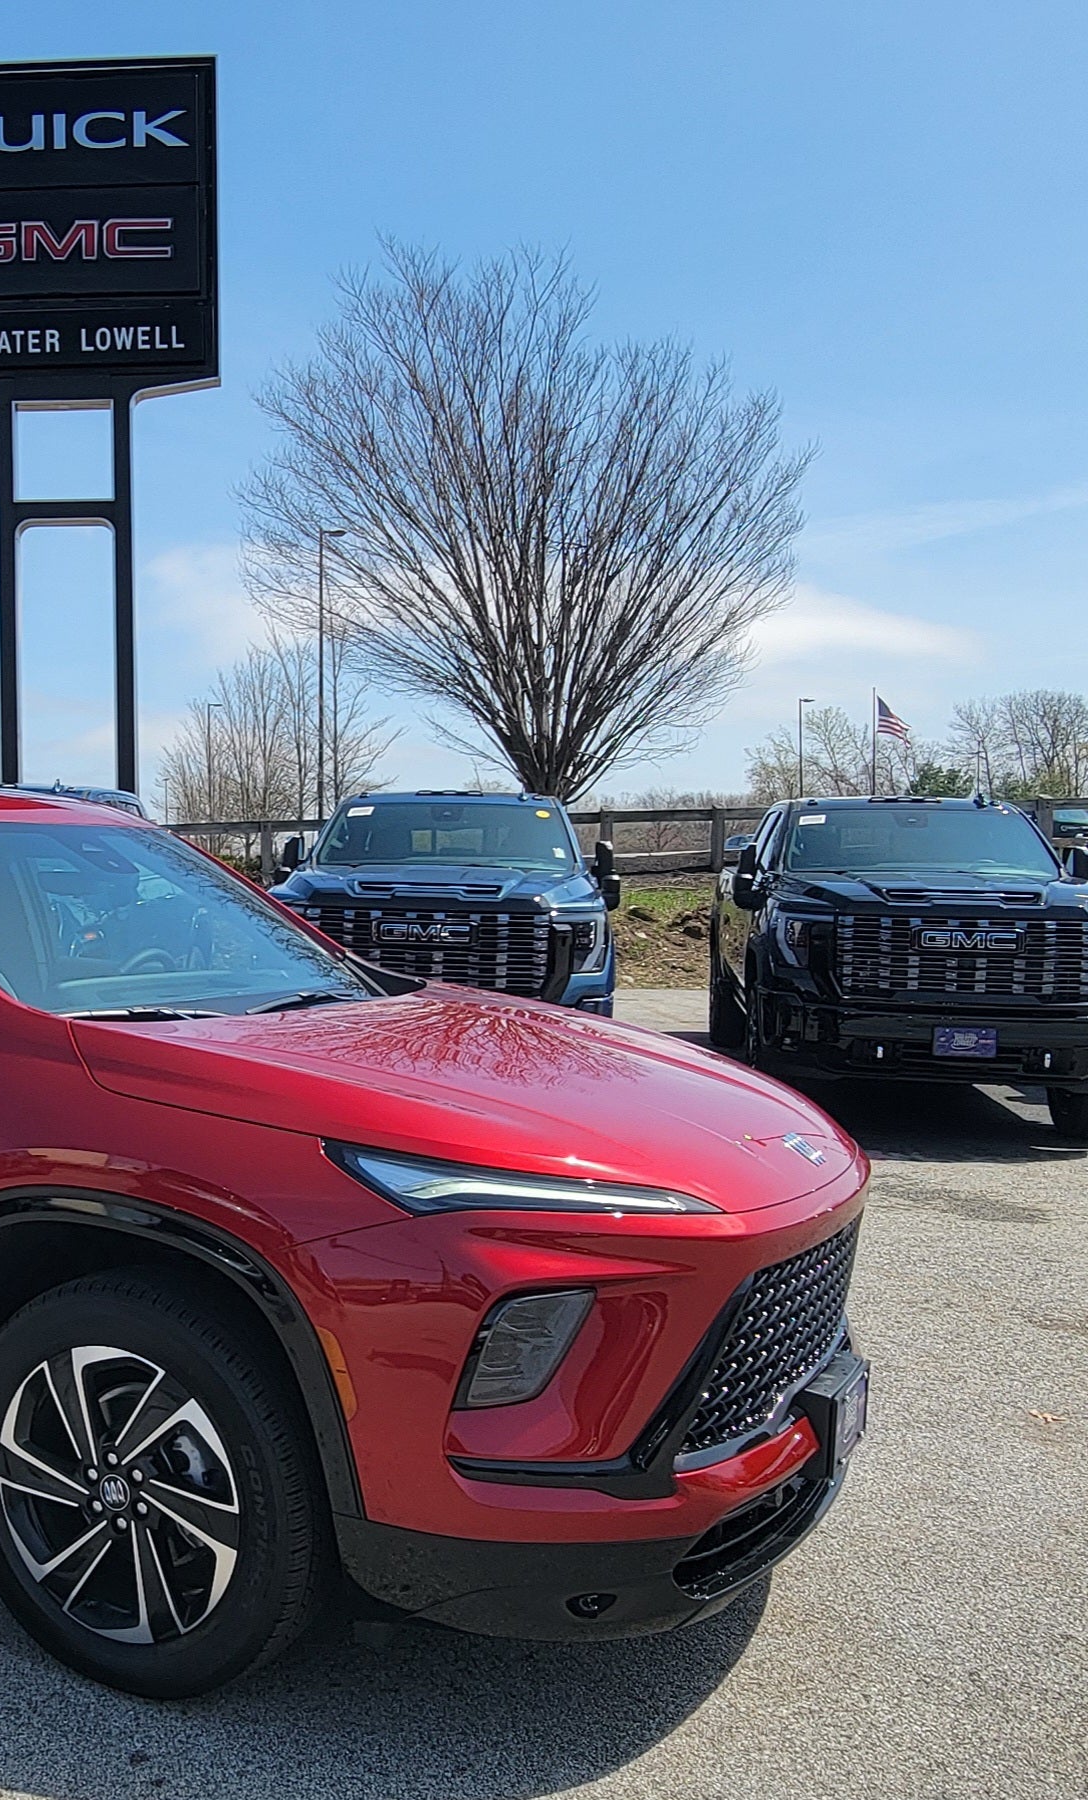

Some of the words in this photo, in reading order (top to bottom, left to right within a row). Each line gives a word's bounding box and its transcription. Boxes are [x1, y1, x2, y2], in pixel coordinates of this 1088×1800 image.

[80, 325, 185, 351] LOWELL
[380, 923, 470, 942] GMC
[921, 931, 1017, 949] GMC
